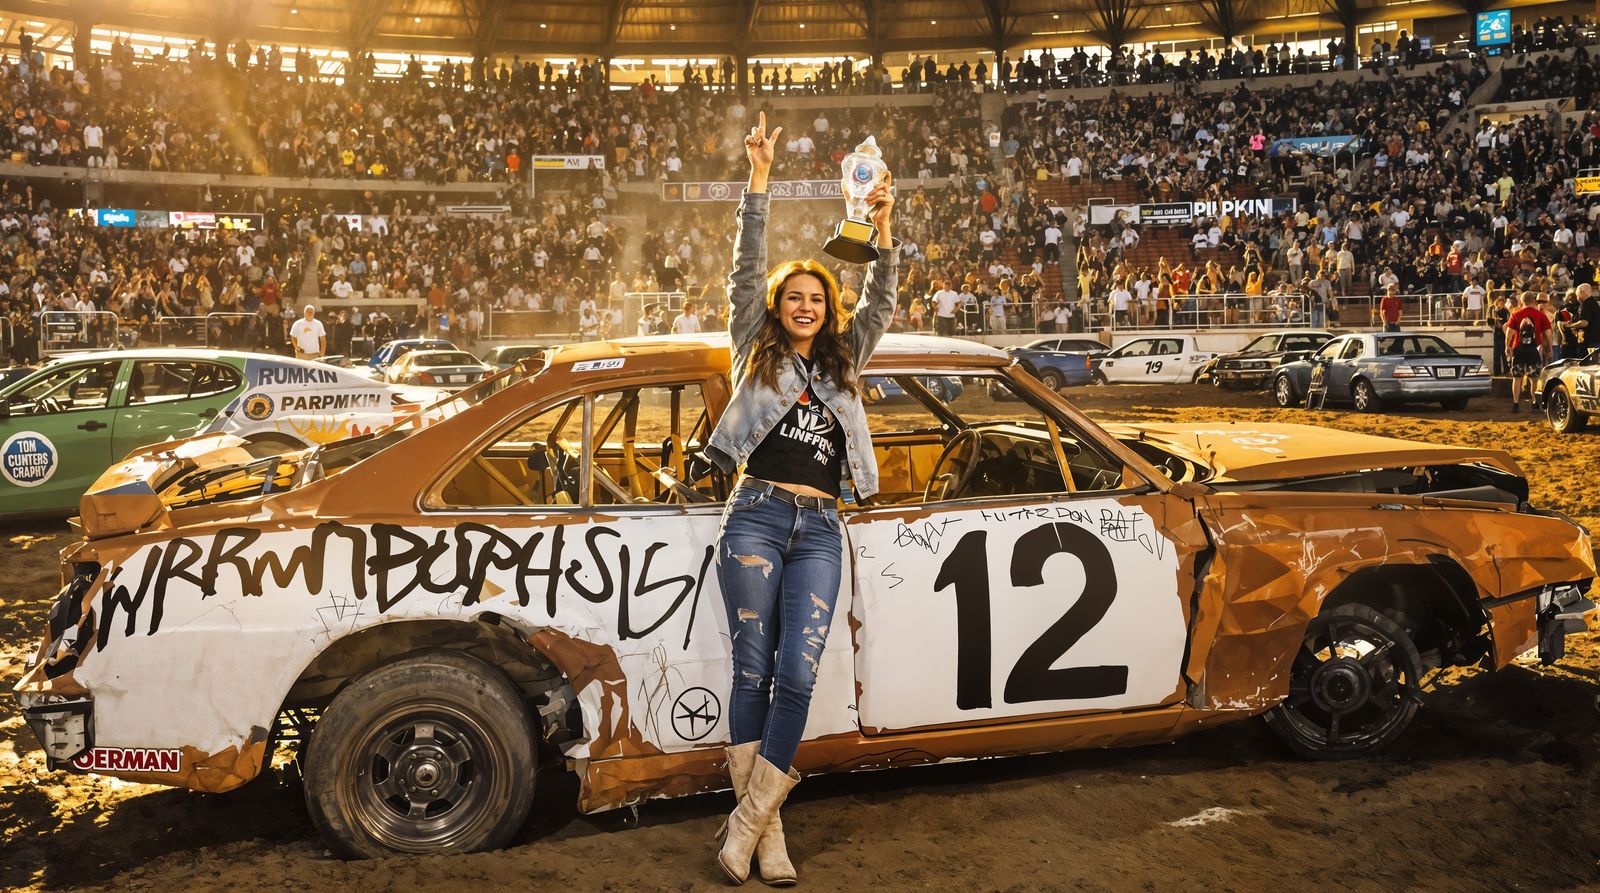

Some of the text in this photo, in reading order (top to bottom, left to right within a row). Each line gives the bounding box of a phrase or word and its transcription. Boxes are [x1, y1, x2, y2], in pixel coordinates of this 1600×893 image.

[258, 367, 338, 387] RUMKIN
[280, 394, 381, 412] PARPMKIN
[16, 440, 37, 453] TOM
[8, 453, 49, 467] CUNTERS
[12, 465, 47, 478] CRAPHY
[934, 528, 1129, 711] 12
